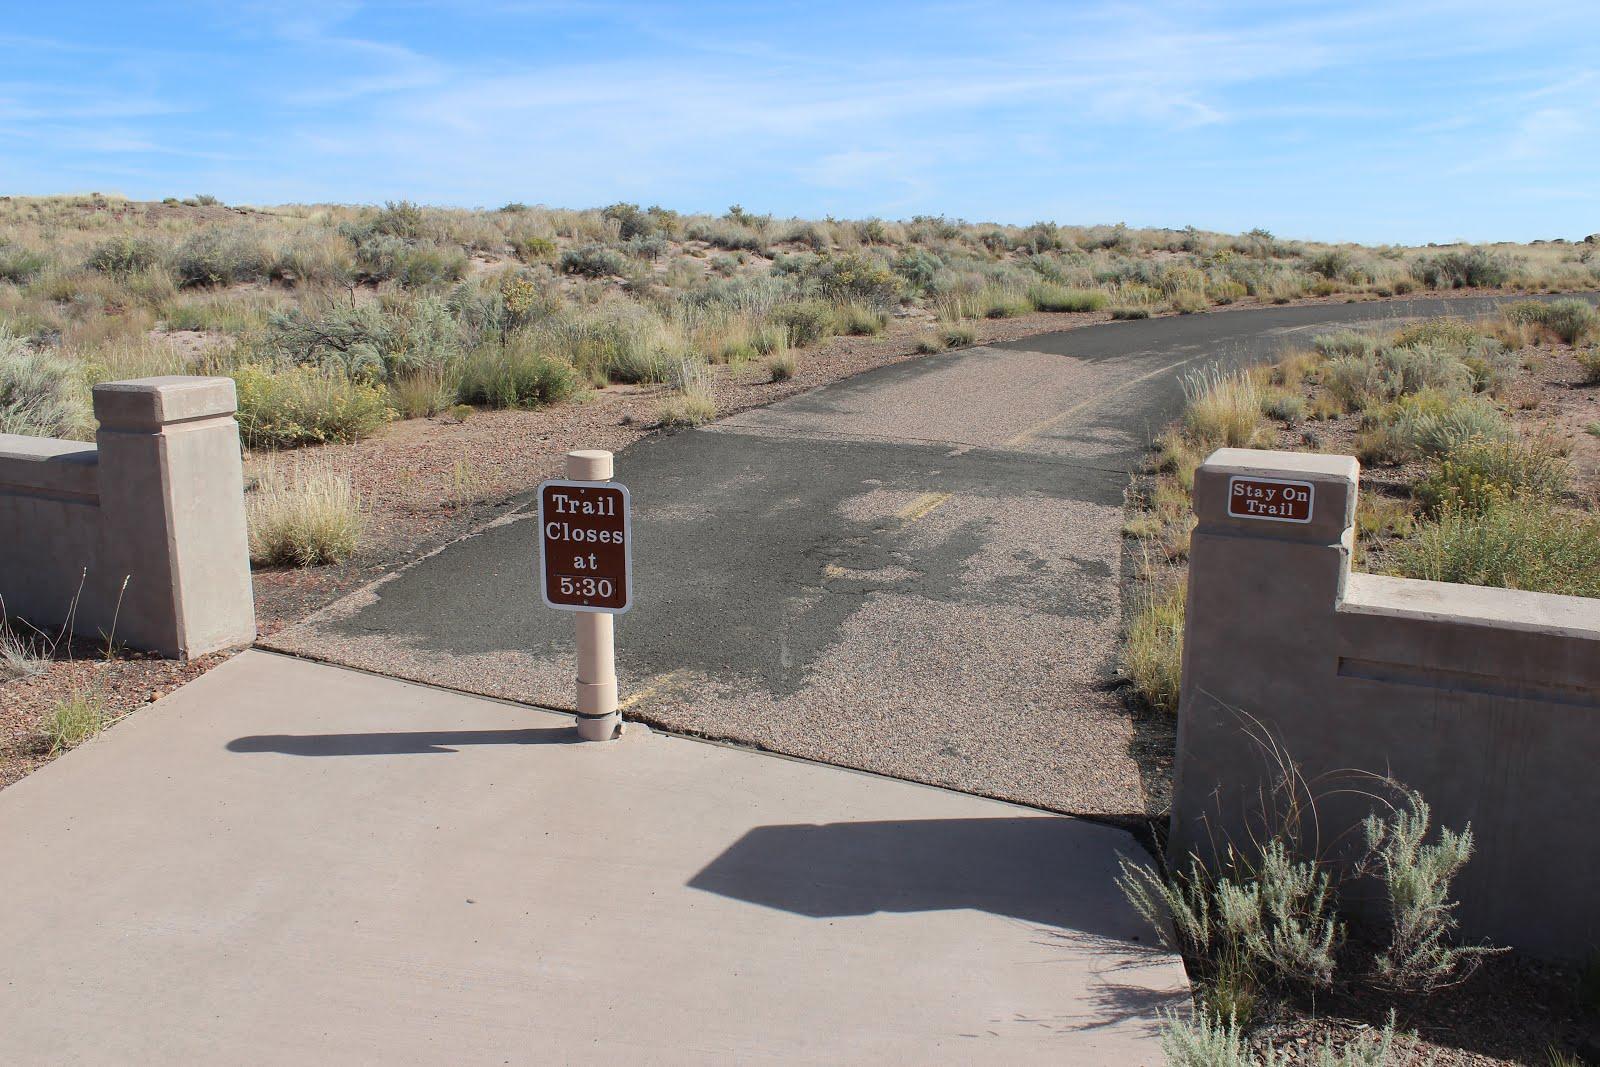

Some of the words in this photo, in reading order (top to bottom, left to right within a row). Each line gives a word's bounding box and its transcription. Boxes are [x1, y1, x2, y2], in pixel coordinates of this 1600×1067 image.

[1233, 483, 1277, 501] Stay
[1283, 487, 1308, 502] On
[552, 494, 615, 516] Trail
[1246, 499, 1293, 515] Trail
[546, 521, 623, 544] Closes
[573, 553, 598, 570] at
[560, 577, 612, 598] 5:30
